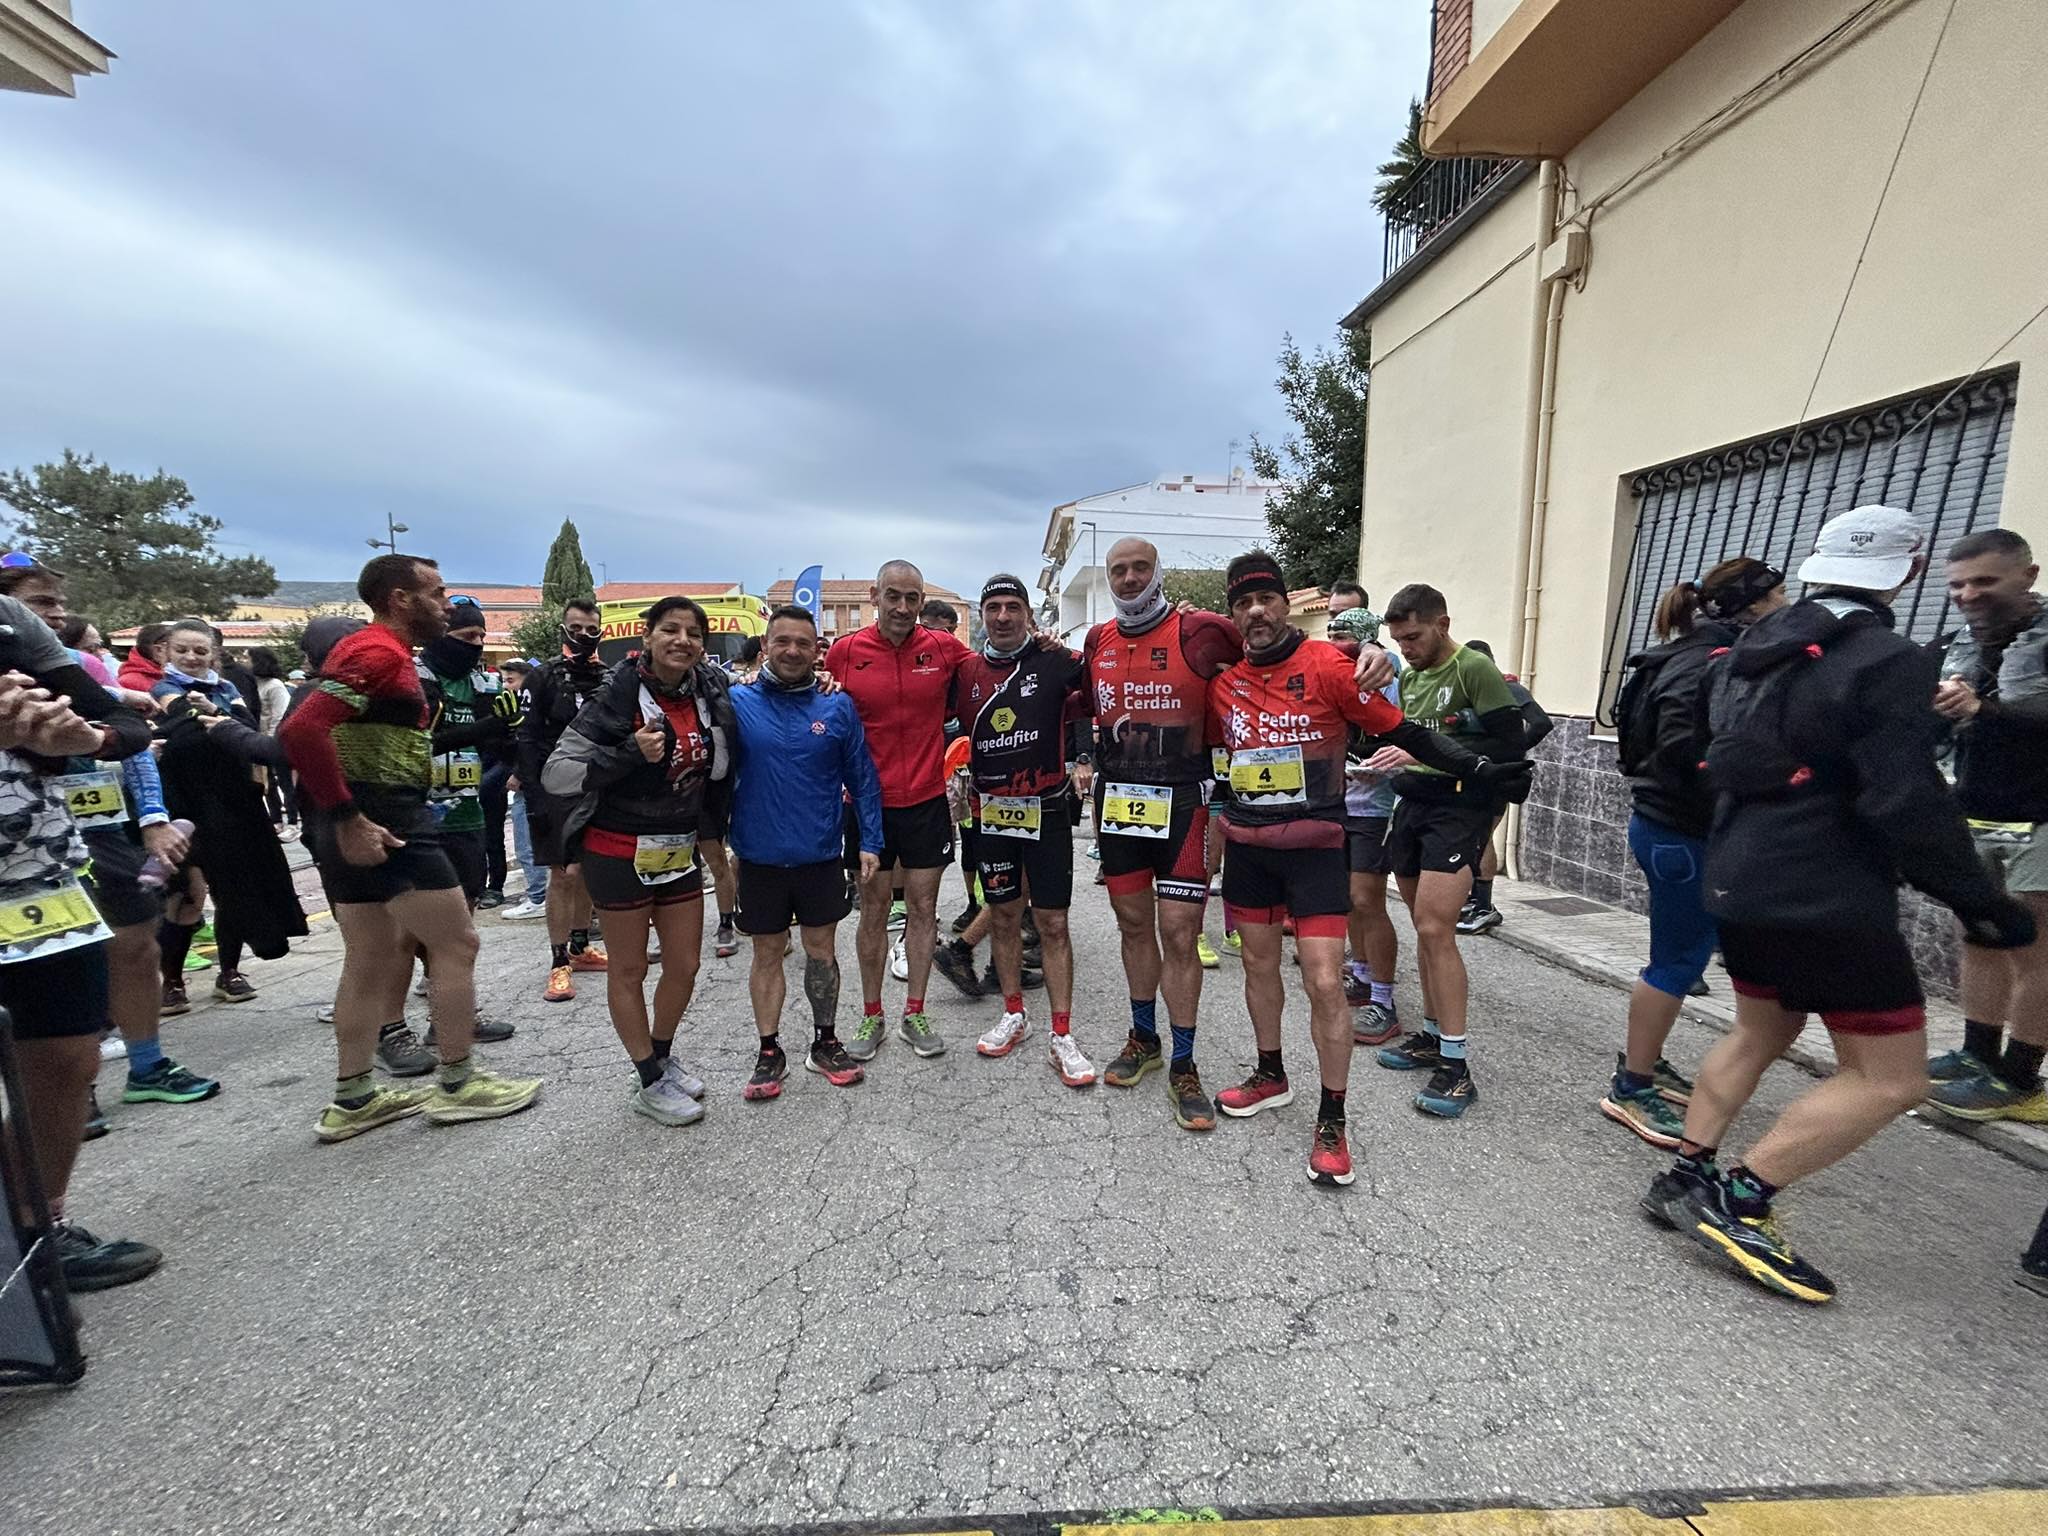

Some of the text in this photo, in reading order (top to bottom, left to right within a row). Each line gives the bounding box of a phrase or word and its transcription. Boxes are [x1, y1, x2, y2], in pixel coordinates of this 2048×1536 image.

[602, 616, 742, 639] AMBCIA
[1123, 680, 1173, 695] Pedro
[1124, 695, 1182, 710] Cerdán
[1258, 710, 1311, 728] Pedro
[976, 730, 1039, 753] ugedafita
[1258, 727, 1324, 743] Cerdán
[458, 767, 472, 779] 81
[1258, 767, 1272, 783] 4
[71, 790, 101, 807] 43
[997, 809, 1026, 821] 170
[1127, 801, 1146, 816] 12
[663, 851, 677, 865] 7
[22, 905, 43, 925] 9
